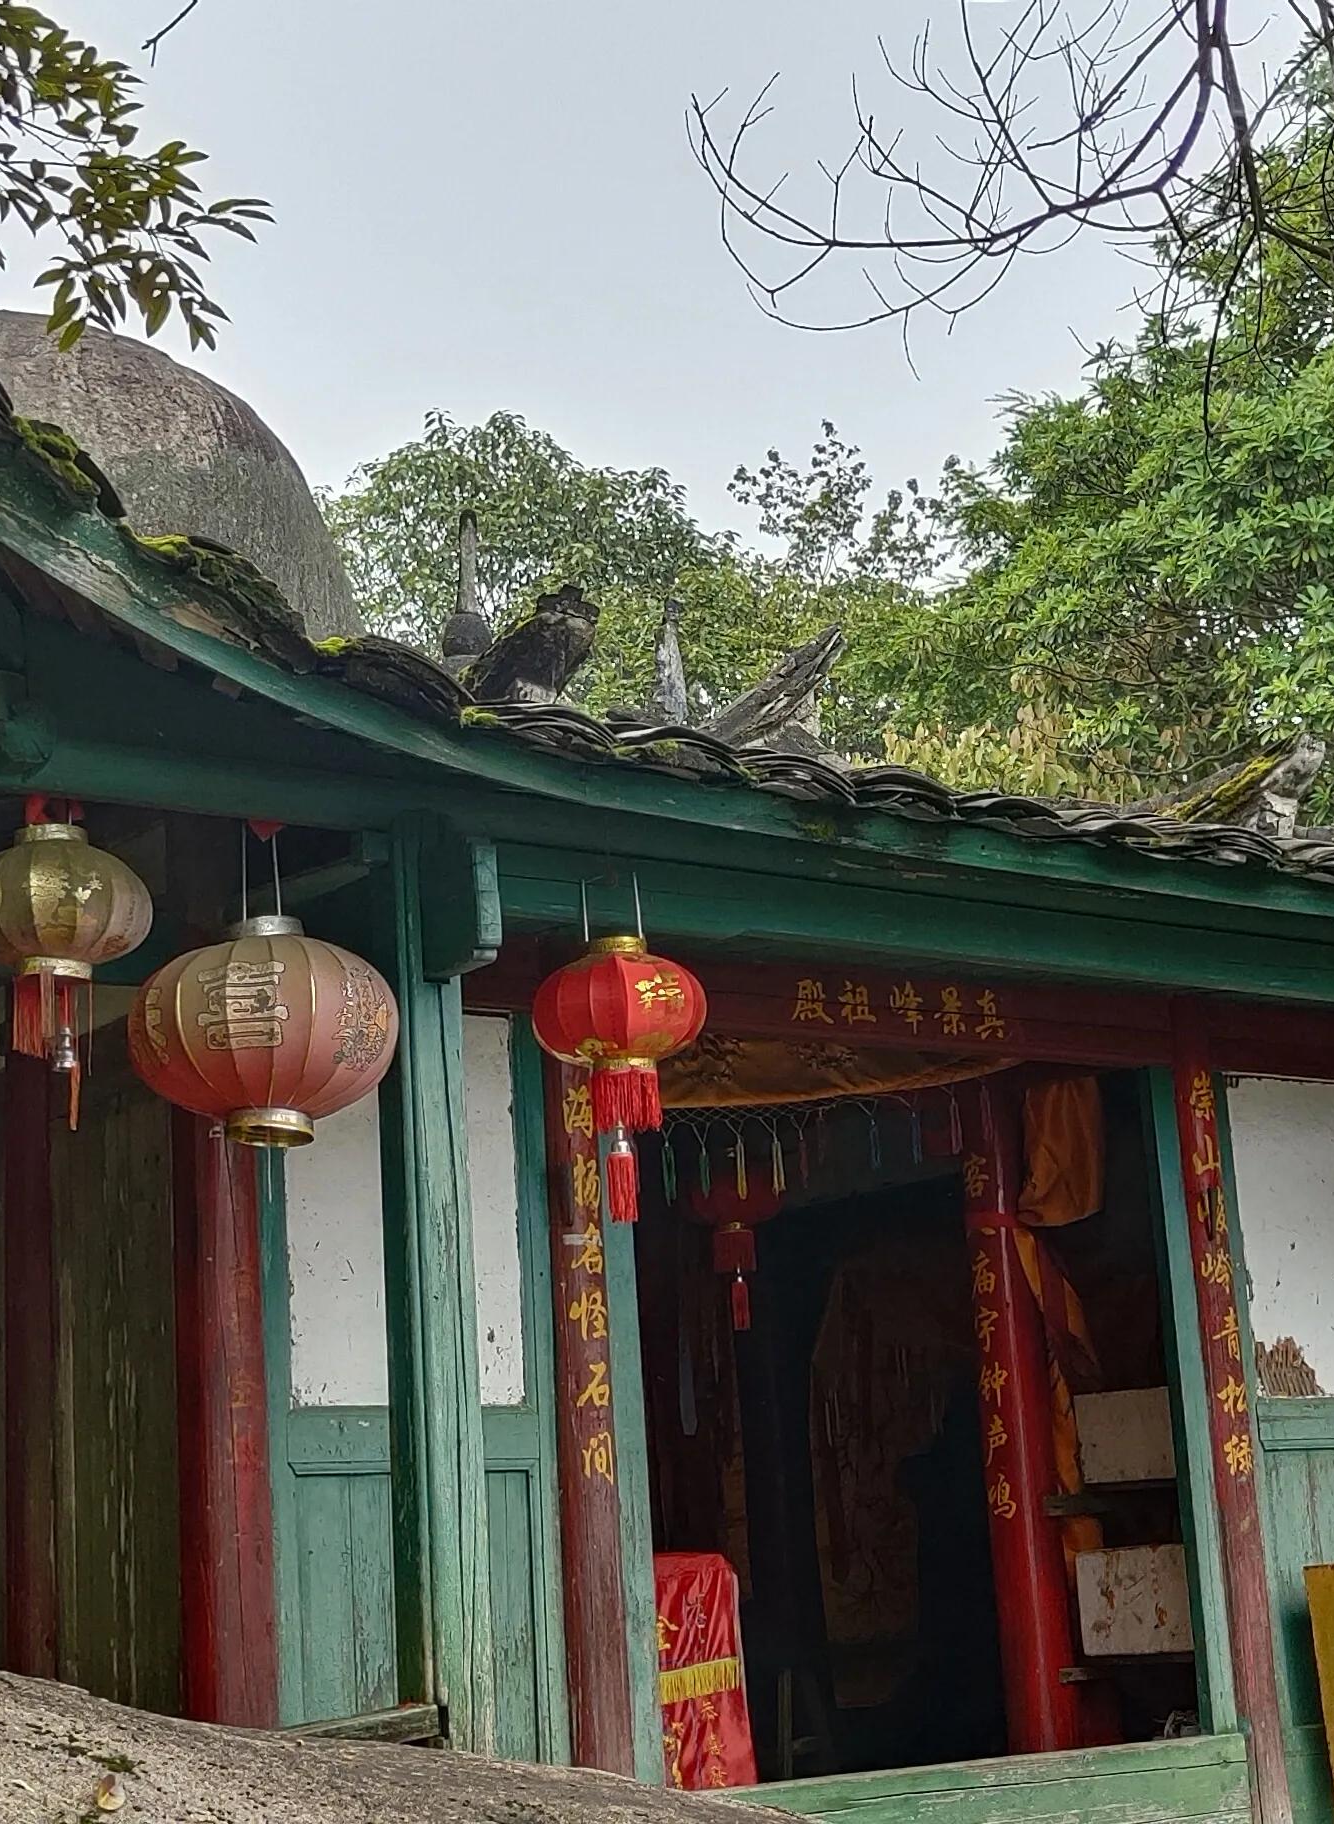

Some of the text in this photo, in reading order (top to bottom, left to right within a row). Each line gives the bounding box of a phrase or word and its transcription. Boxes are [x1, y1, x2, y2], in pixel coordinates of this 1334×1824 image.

[964, 1154, 1017, 1519] 客庙宇钟声鸣
